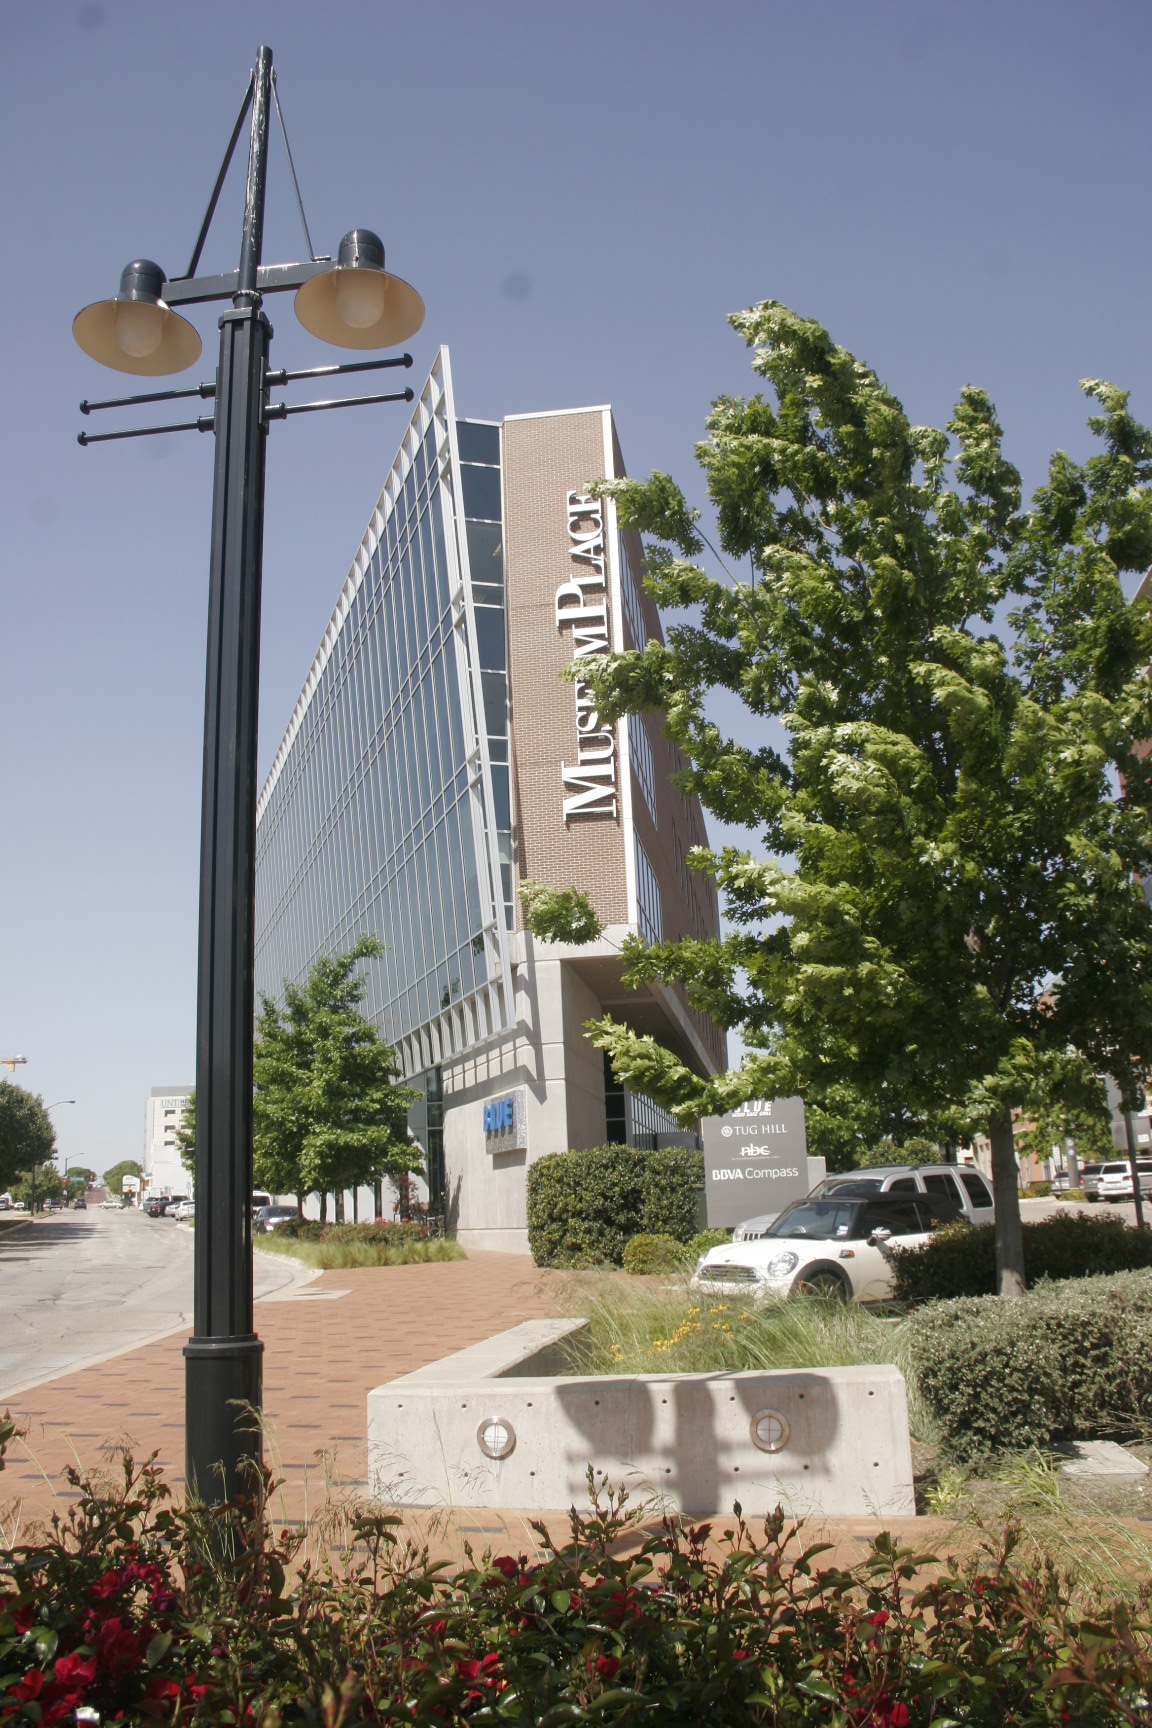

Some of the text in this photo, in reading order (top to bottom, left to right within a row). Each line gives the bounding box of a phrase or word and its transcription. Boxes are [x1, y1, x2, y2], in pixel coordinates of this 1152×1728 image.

[561, 624, 617, 821] MUSEM
[734, 1123, 787, 1136] TUG HILL
[712, 1167, 798, 1180] BBVA Compass
